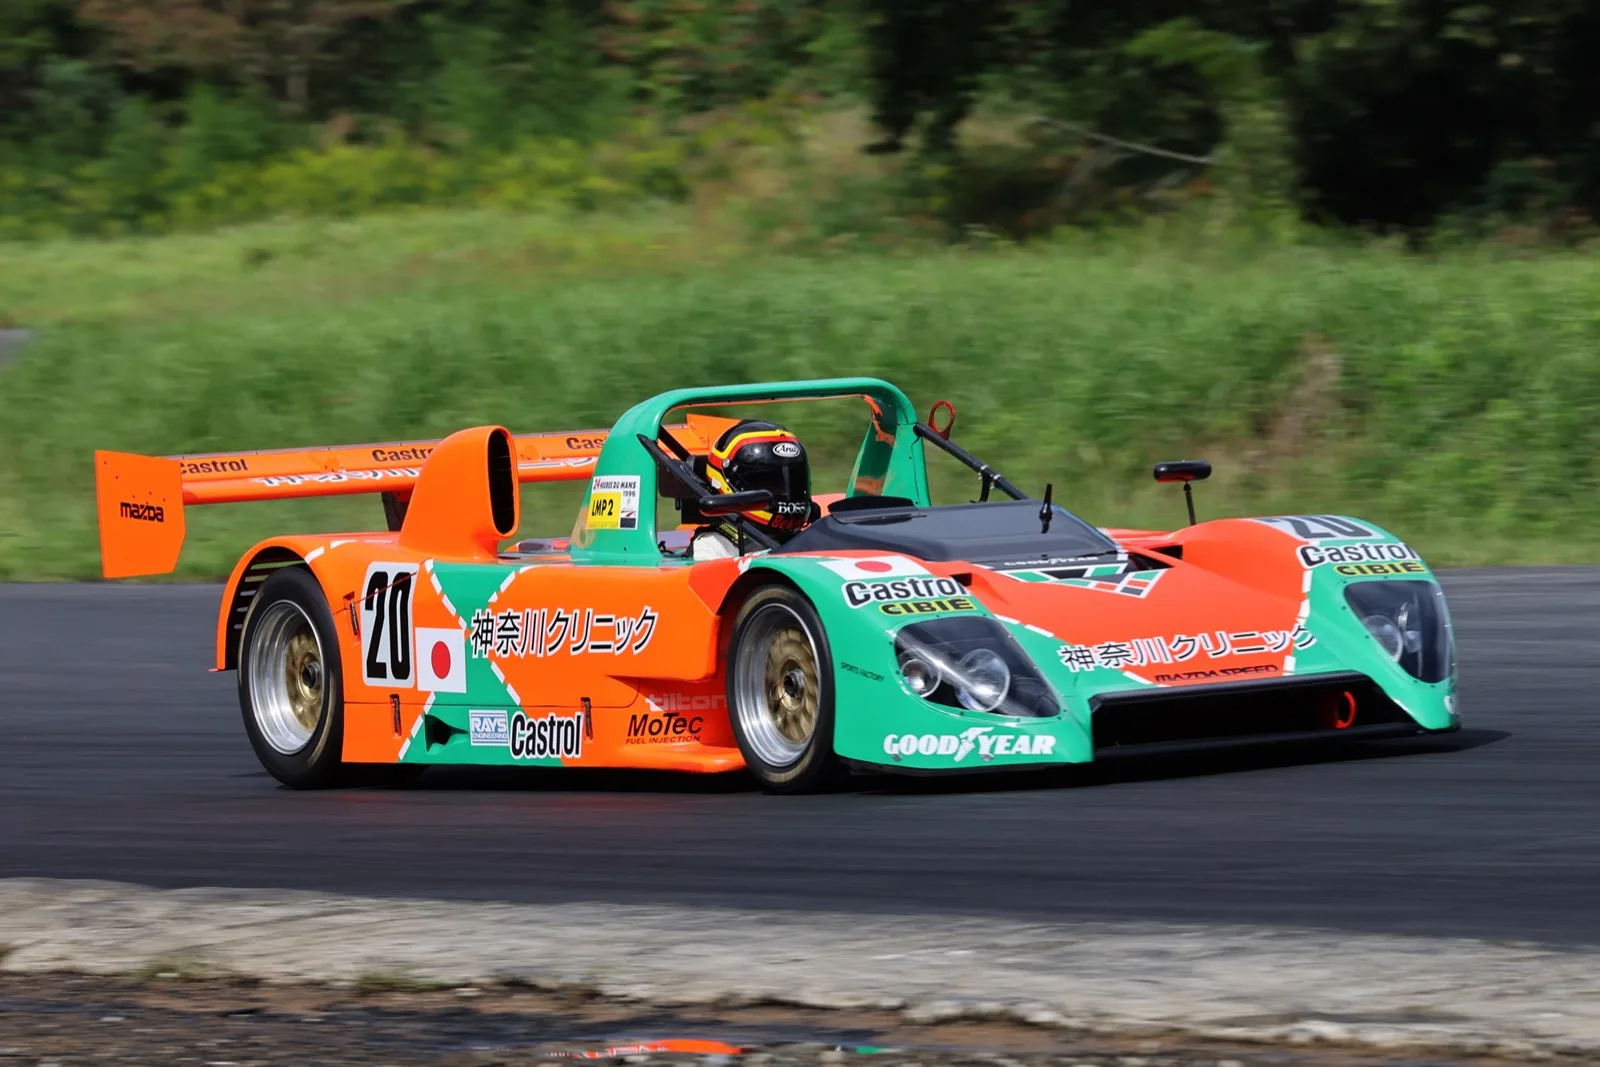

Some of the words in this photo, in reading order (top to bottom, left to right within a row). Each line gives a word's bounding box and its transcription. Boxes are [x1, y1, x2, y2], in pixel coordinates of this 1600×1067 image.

[566, 436, 607, 450] Cas
[779, 443, 797, 453] Arai
[593, 478, 601, 490] 24
[613, 481, 620, 489] DU
[620, 481, 636, 489] MANS
[591, 499, 607, 516] LMP
[607, 498, 614, 516] 2
[777, 501, 807, 514] BOSS
[1256, 515, 1373, 539] 20
[1299, 542, 1418, 567] Castrol
[1336, 562, 1426, 575] CIBIE
[844, 577, 968, 607] Castrol
[880, 598, 975, 615] CIBIE
[365, 571, 412, 680] 20
[471, 606, 658, 658] 神奈川クリニック
[1059, 624, 1317, 671] 神奈川クリニック
[472, 716, 507, 732] RAYS
[472, 732, 508, 740] ENGINEERING
[511, 712, 582, 757] Castrol
[648, 735, 701, 743] INJECTION
